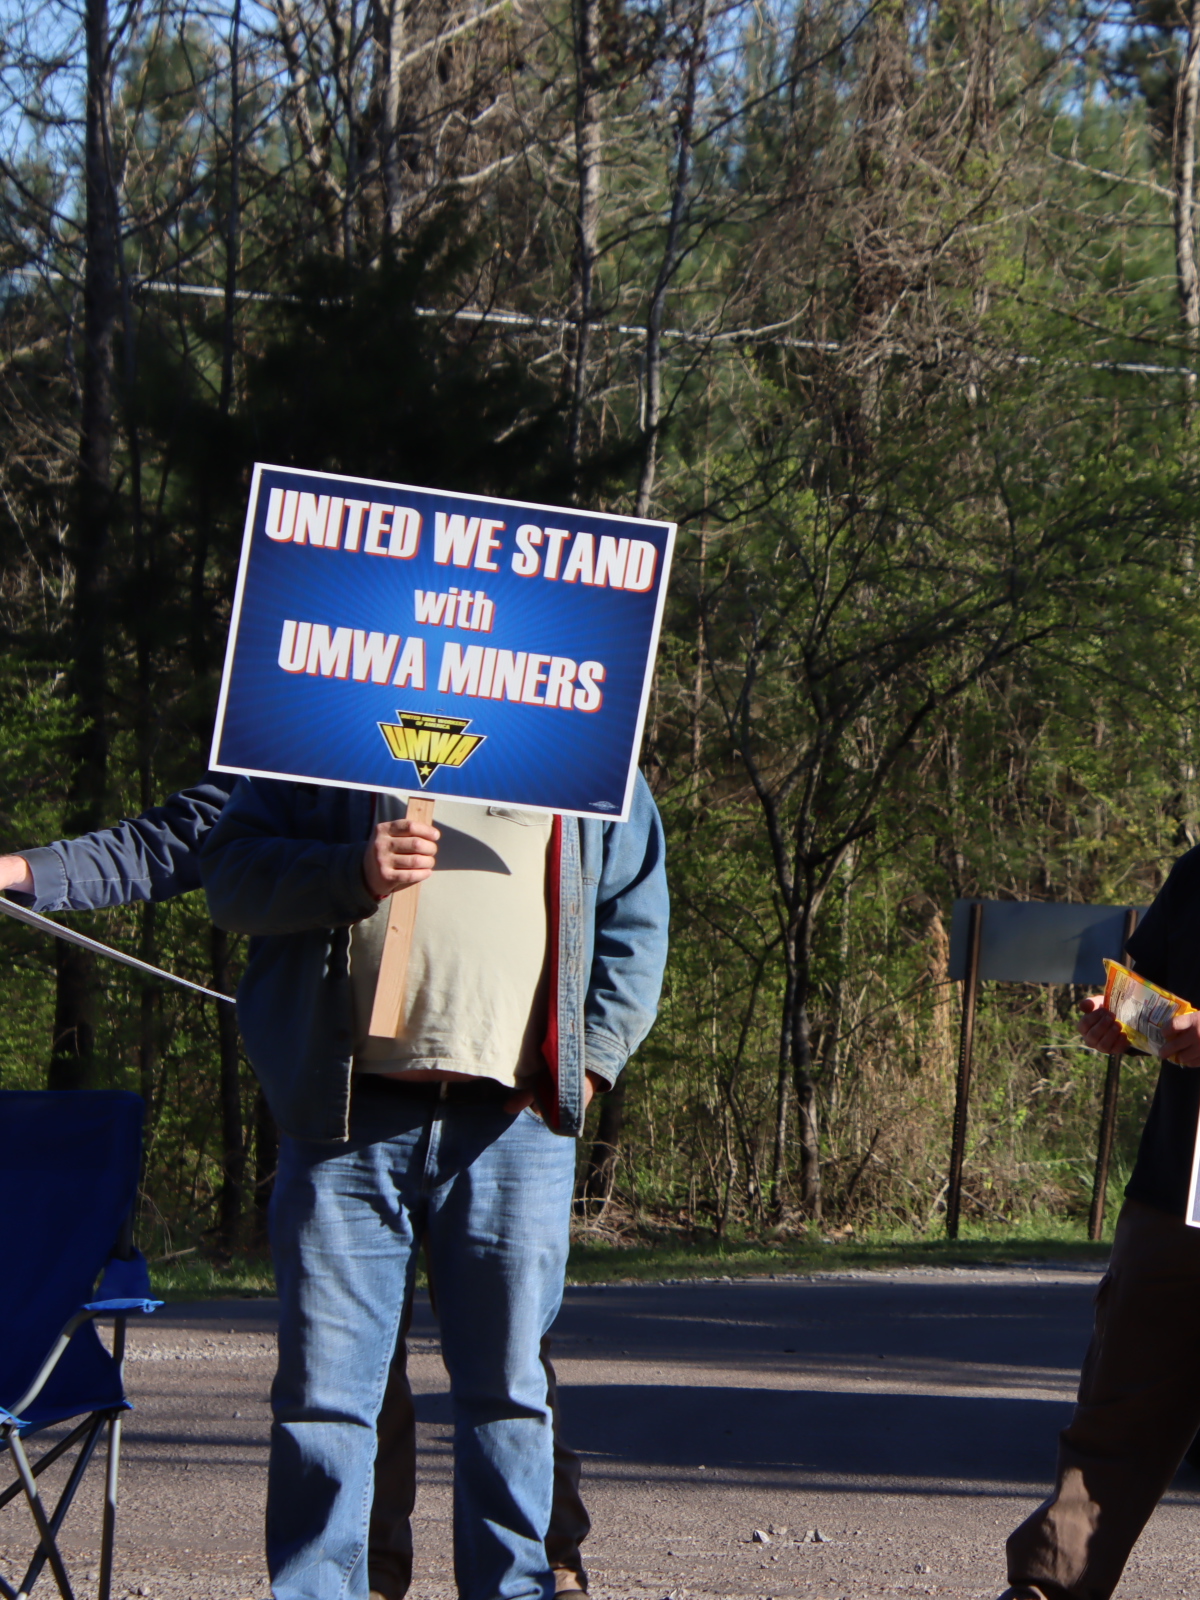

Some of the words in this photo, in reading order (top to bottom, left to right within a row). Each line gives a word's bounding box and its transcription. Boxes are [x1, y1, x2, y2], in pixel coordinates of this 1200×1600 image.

[264, 488, 422, 560] UNITED
[433, 511, 505, 572] WE
[511, 524, 657, 593] STAND
[414, 587, 496, 633] with
[278, 619, 426, 690] UMWA
[437, 641, 606, 713] MINERS
[382, 724, 479, 766] UMWA
